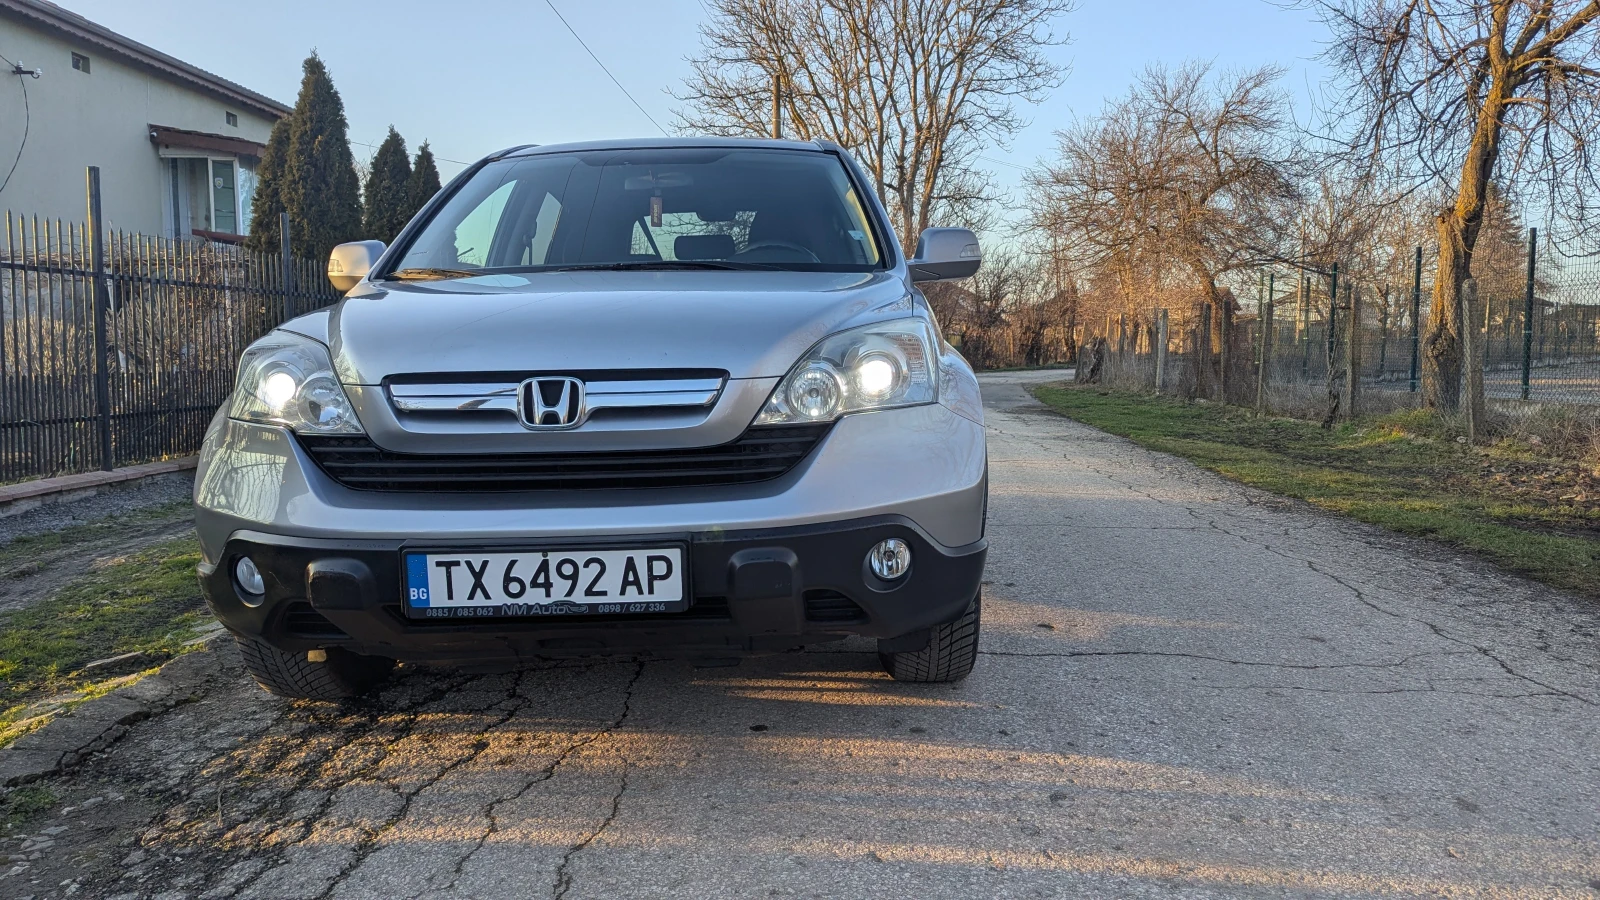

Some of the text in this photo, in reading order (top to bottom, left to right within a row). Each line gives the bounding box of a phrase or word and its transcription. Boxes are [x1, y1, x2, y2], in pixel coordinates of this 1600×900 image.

[435, 555, 673, 600] TX 6492 AP
[410, 588, 427, 600] BG
[426, 608, 449, 617] 0885
[457, 607, 474, 616] 085
[476, 607, 494, 616] 062
[501, 604, 566, 616] NM Auto
[598, 604, 621, 613] 0898
[629, 603, 646, 612] 627
[648, 602, 666, 611] 336
